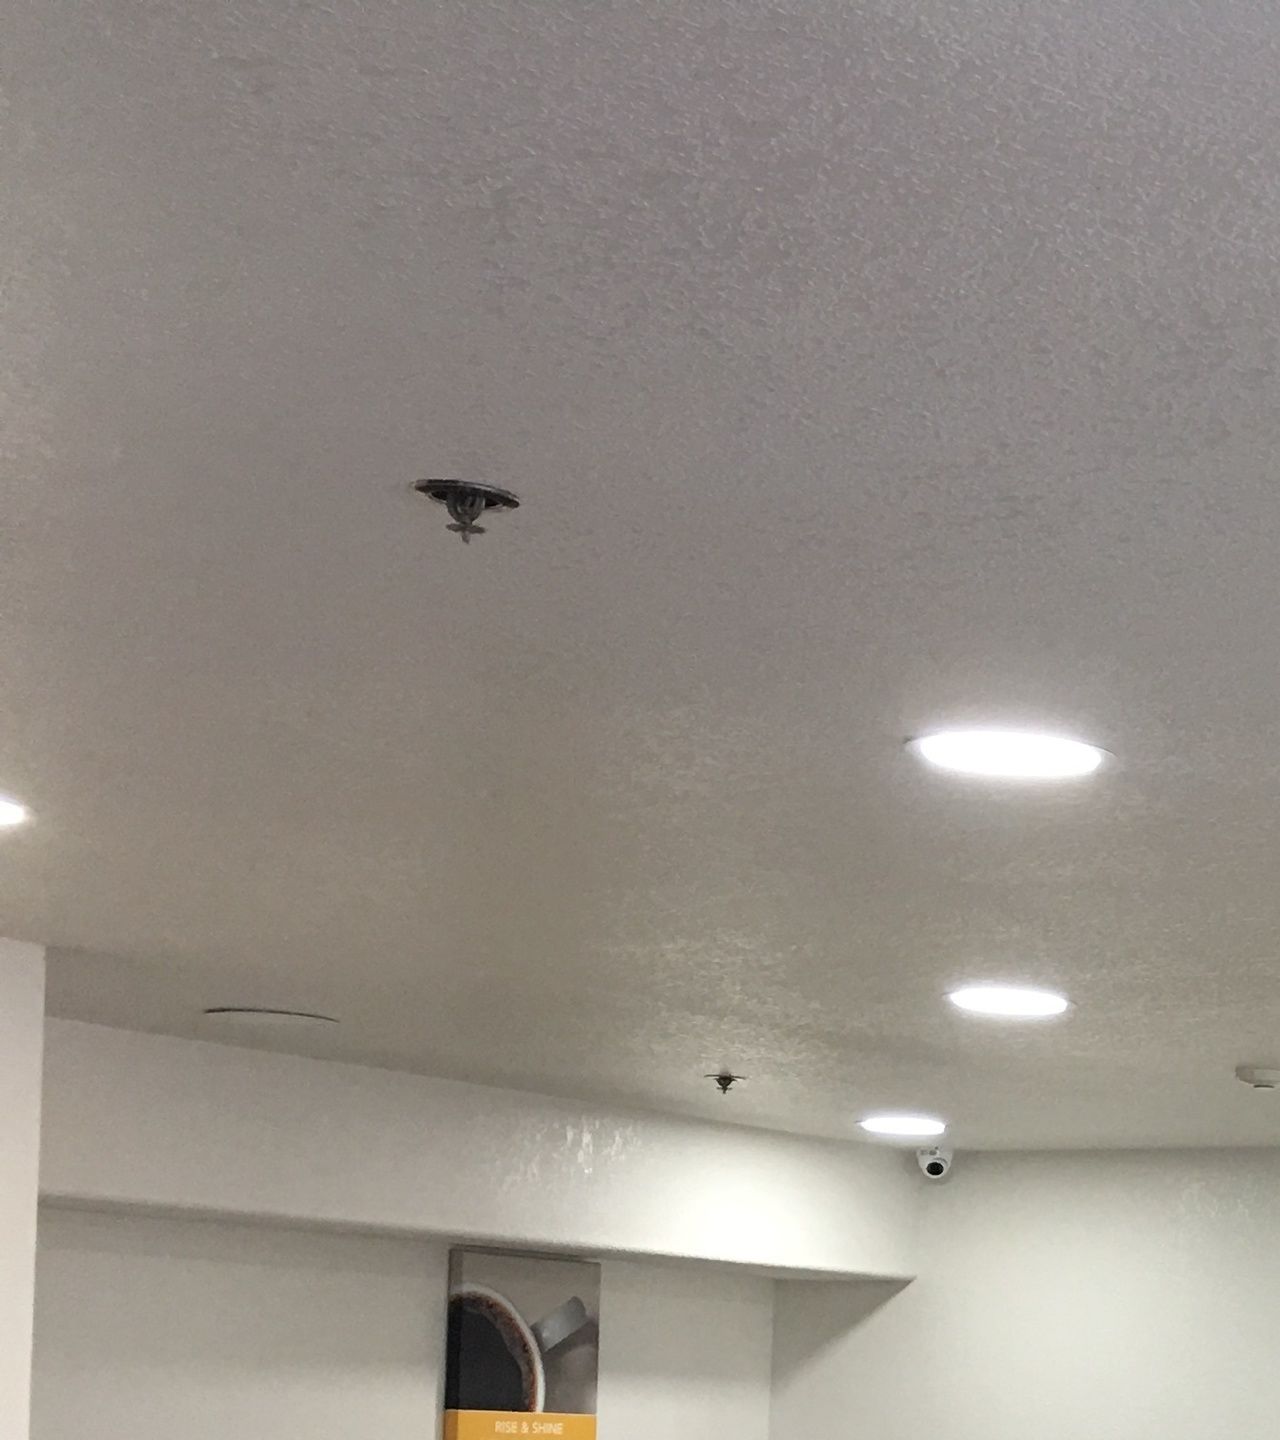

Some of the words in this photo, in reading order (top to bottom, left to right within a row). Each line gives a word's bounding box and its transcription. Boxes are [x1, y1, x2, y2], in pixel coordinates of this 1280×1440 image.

[494, 1420, 518, 1434] RISE
[520, 1421, 530, 1434] &
[532, 1422, 564, 1435] SHINE
